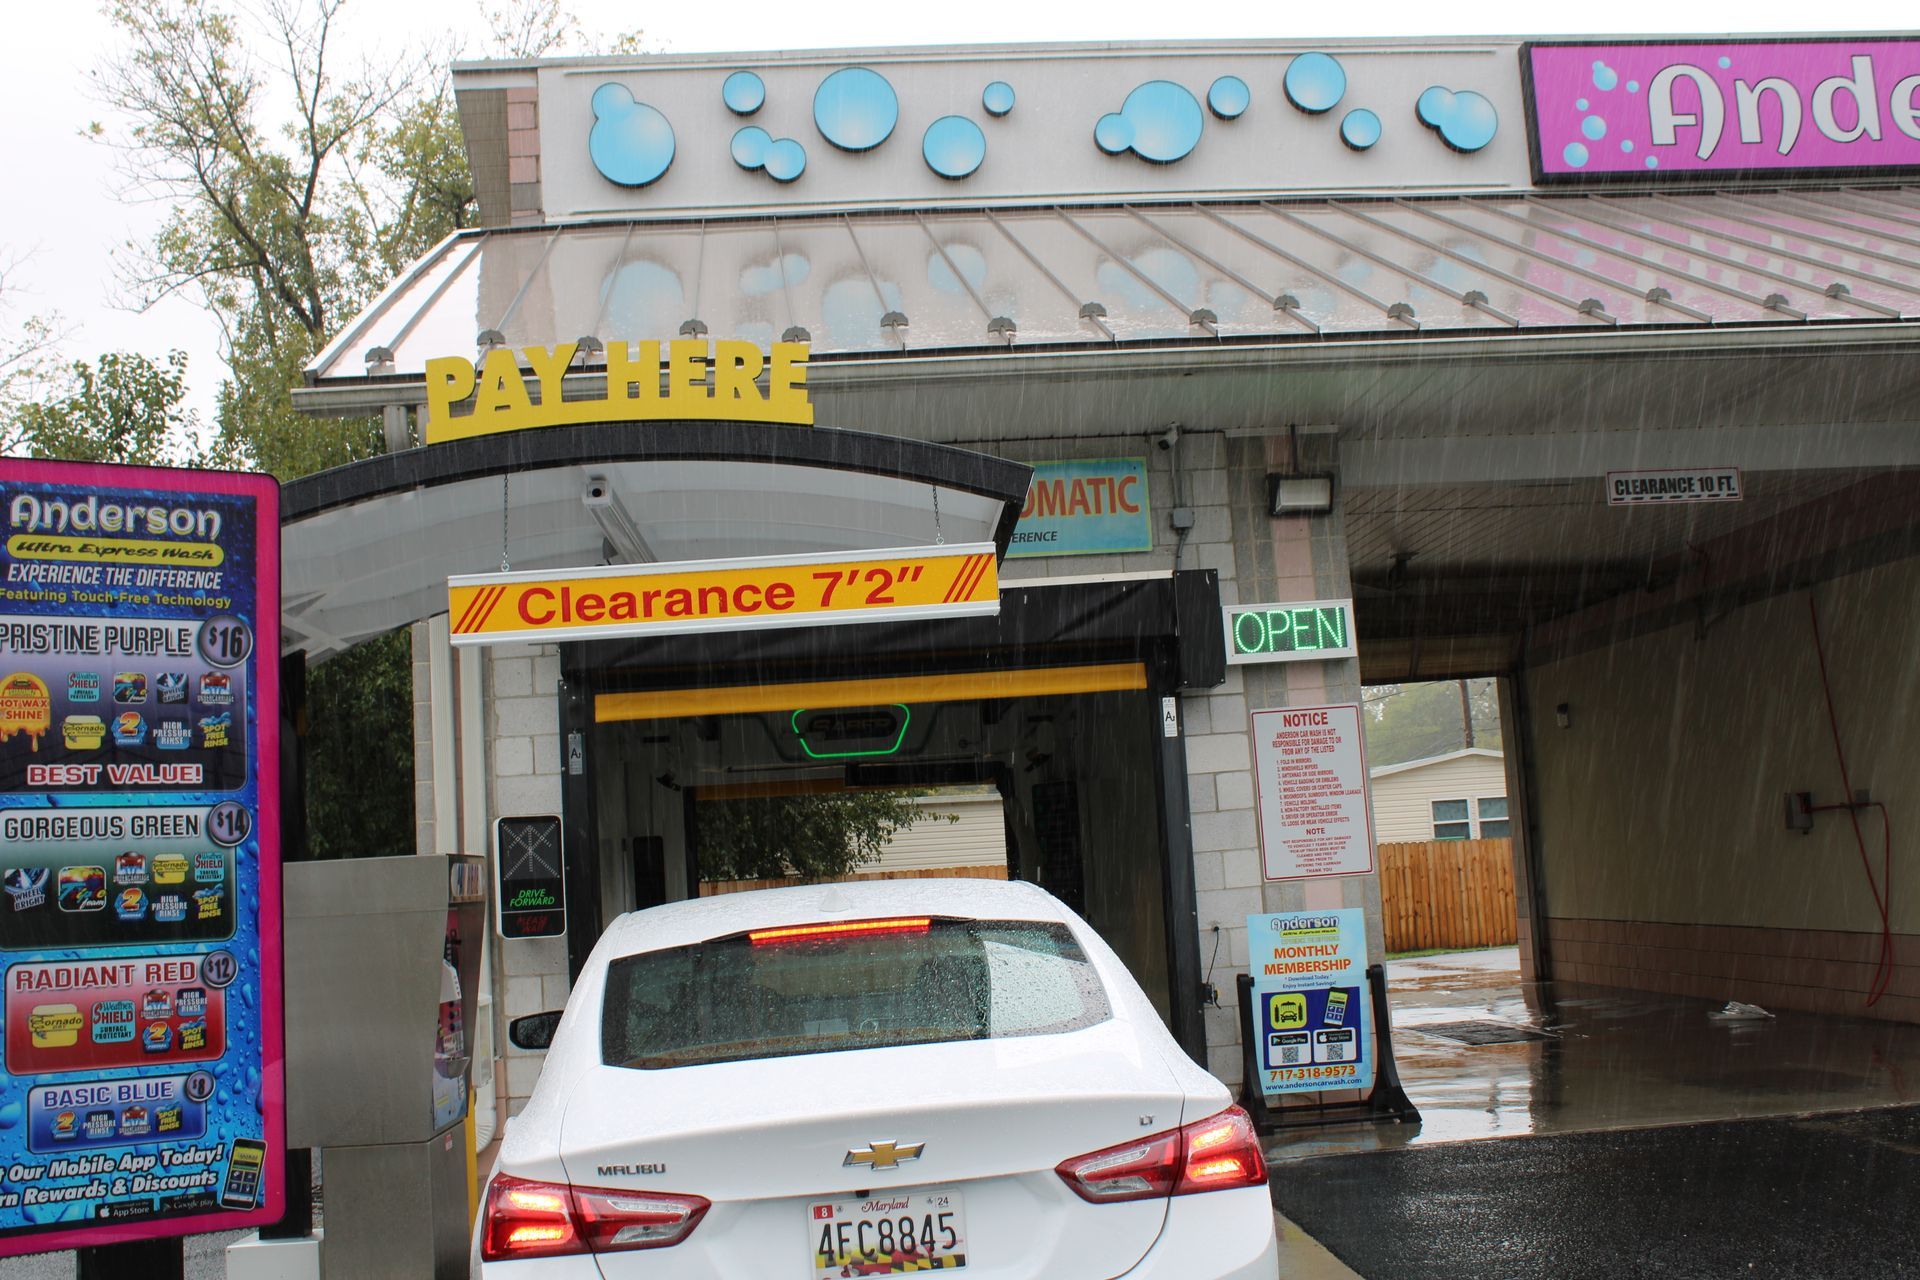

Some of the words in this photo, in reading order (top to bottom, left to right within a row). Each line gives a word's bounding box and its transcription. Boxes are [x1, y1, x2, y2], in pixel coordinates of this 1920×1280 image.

[1647, 54, 1920, 161] Ande
[425, 343, 580, 426] PAY
[607, 339, 812, 408] HERE
[1614, 477, 1695, 496] CLEARANCE
[1697, 476, 1714, 492] 10
[1717, 475, 1736, 492] FT.
[1019, 475, 1140, 519] OMATIC
[10, 494, 221, 540] Anderson
[1011, 530, 1058, 544] ERENCE
[16, 541, 73, 553] Ultra
[78, 543, 159, 558] Express
[162, 548, 214, 560] Wash
[8, 563, 102, 584] EXPERIENCE
[106, 567, 134, 586] THE
[136, 568, 223, 590] DIFFERENCE
[0, 588, 66, 603] Featuring
[72, 590, 150, 604] Touch-Free
[155, 593, 232, 609] Technology
[516, 579, 796, 626] Clearance
[1235, 606, 1344, 653] OPEN
[0, 623, 99, 652] PRISTINE
[104, 626, 190, 654] PURPLE
[209, 625, 244, 658] $16
[22, 698, 47, 708] WAX
[6, 710, 42, 720] SHINE
[1283, 712, 1329, 728] NOTICE
[119, 712, 140, 736] 2
[162, 721, 182, 730] HIGH
[203, 724, 226, 734] SPOT
[153, 729, 192, 738] PRESSURE
[161, 737, 184, 745] RINSE
[206, 732, 225, 740] FREE
[204, 738, 228, 748] RINSE
[27, 764, 102, 785] BEST
[107, 764, 203, 784] VALUE!
[4, 816, 124, 839] GORGEOUS
[131, 815, 199, 836] GREEN
[217, 808, 246, 836] $14
[14, 888, 41, 900] WHEEL
[122, 888, 142, 911] 2
[198, 895, 219, 905] SPOT
[519, 888, 546, 898] DRIVE
[15, 894, 45, 911] BRIGHT
[152, 902, 188, 911] PRESSURE
[200, 903, 218, 911] FREE
[510, 896, 555, 907] FORWARD
[1271, 916, 1340, 931] Anderson
[1274, 944, 1339, 959] MONTHLY
[16, 964, 135, 990] RADIANT
[145, 962, 196, 983] RED
[208, 957, 230, 979] $12
[1264, 958, 1351, 975] MEMBERSHIP
[175, 998, 208, 1006] PRESSURE
[183, 991, 200, 999] HIGH
[92, 1003, 134, 1024] SHIELD
[150, 1021, 168, 1042] 2
[182, 1026, 202, 1036] SPOT
[184, 1034, 202, 1042] FREE
[1270, 1065, 1356, 1081] 717-318-9573
[1265, 1078, 1362, 1091] www.andersoncarwash.com
[44, 1086, 111, 1108] BASIC
[118, 1082, 172, 1102] BLUE
[55, 1111, 75, 1132] 2
[91, 1114, 108, 1122] HIGH
[158, 1110, 178, 1119] SPOT
[83, 1120, 116, 1129] PRESSURE
[9, 1164, 46, 1181] Our
[48, 1156, 115, 1178] Mobile
[118, 1154, 156, 1172] App
[162, 1144, 224, 1166] Today!
[597, 1163, 666, 1176] MALIBU
[24, 1180, 107, 1205] Rewards
[112, 1178, 127, 1195] &
[132, 1171, 217, 1193] Discounts
[861, 1196, 910, 1214] Maryland
[938, 1196, 949, 1206] 24
[114, 1209, 128, 1217] App
[130, 1206, 150, 1214] Store
[821, 1207, 828, 1217] 8
[818, 1212, 957, 1262] 4FC8845
